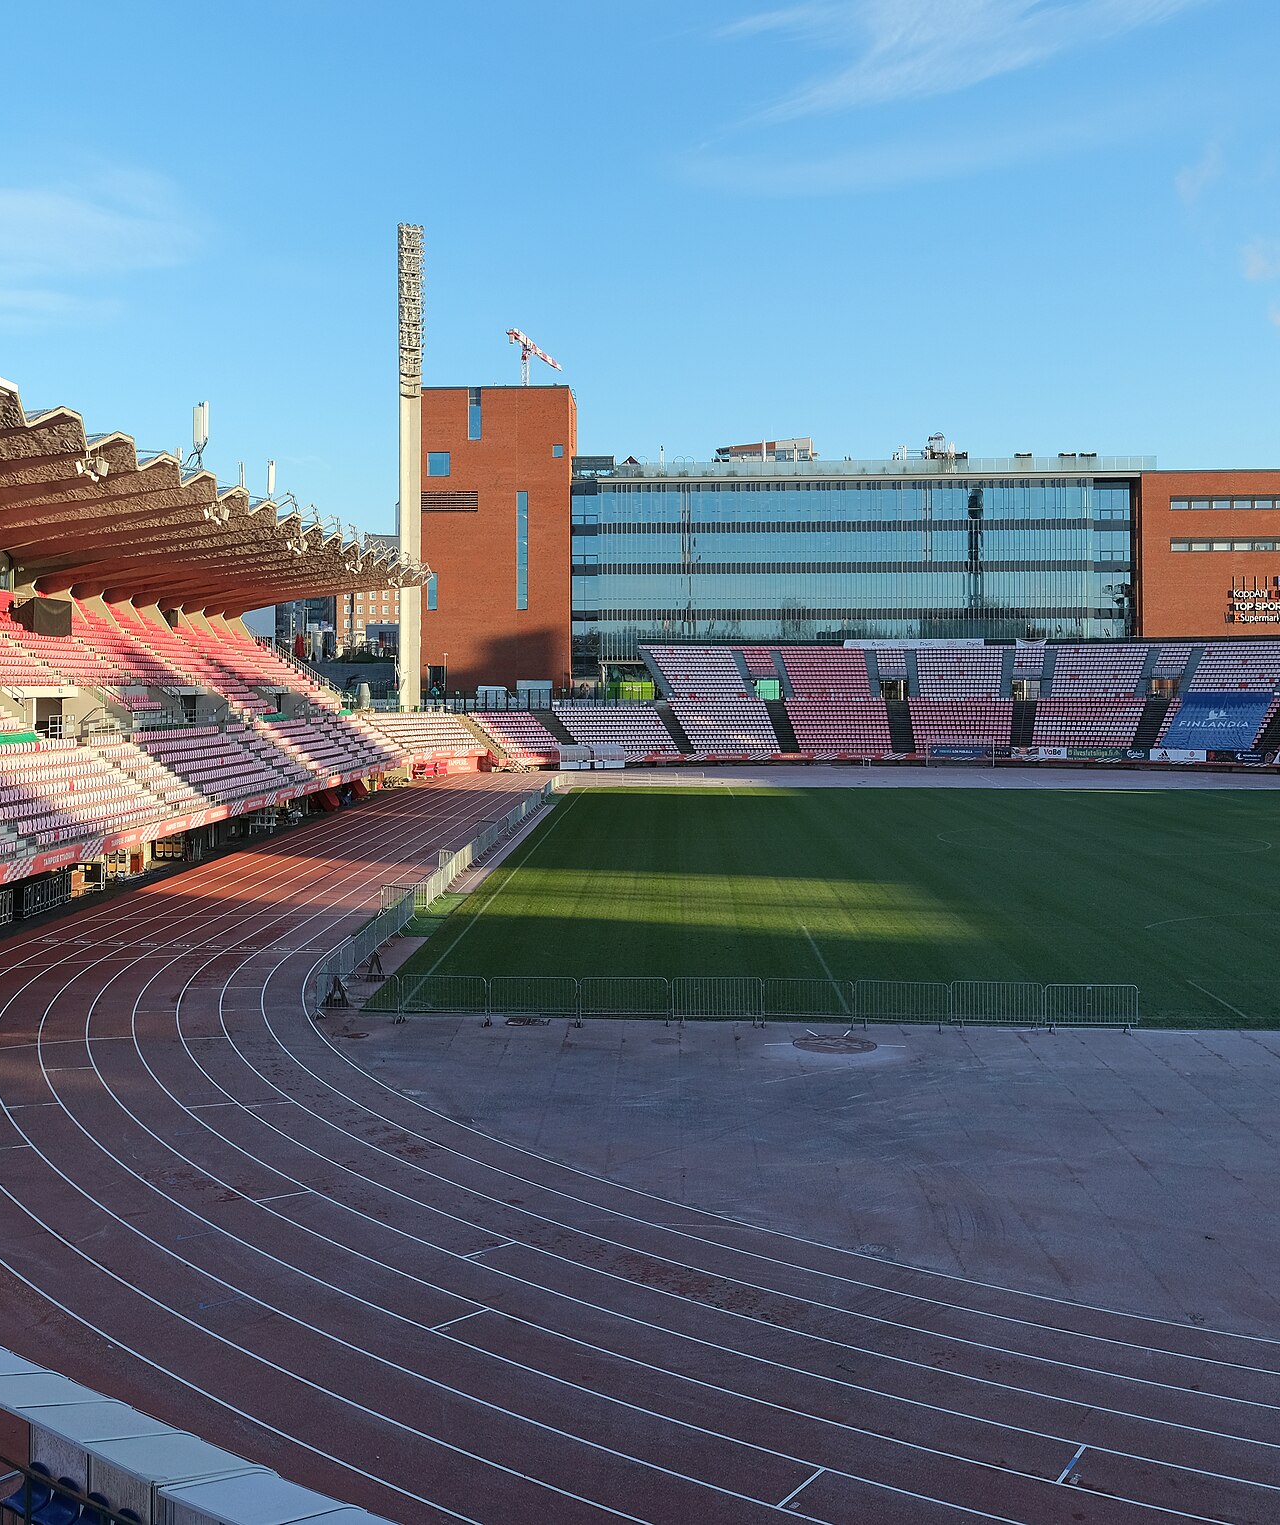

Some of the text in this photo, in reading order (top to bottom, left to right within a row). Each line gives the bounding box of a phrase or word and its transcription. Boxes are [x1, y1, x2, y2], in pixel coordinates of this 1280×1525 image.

[1233, 589, 1268, 599] KappAhl
[1234, 602, 1258, 611] TOP
[1179, 720, 1249, 728] FINLANDIA
